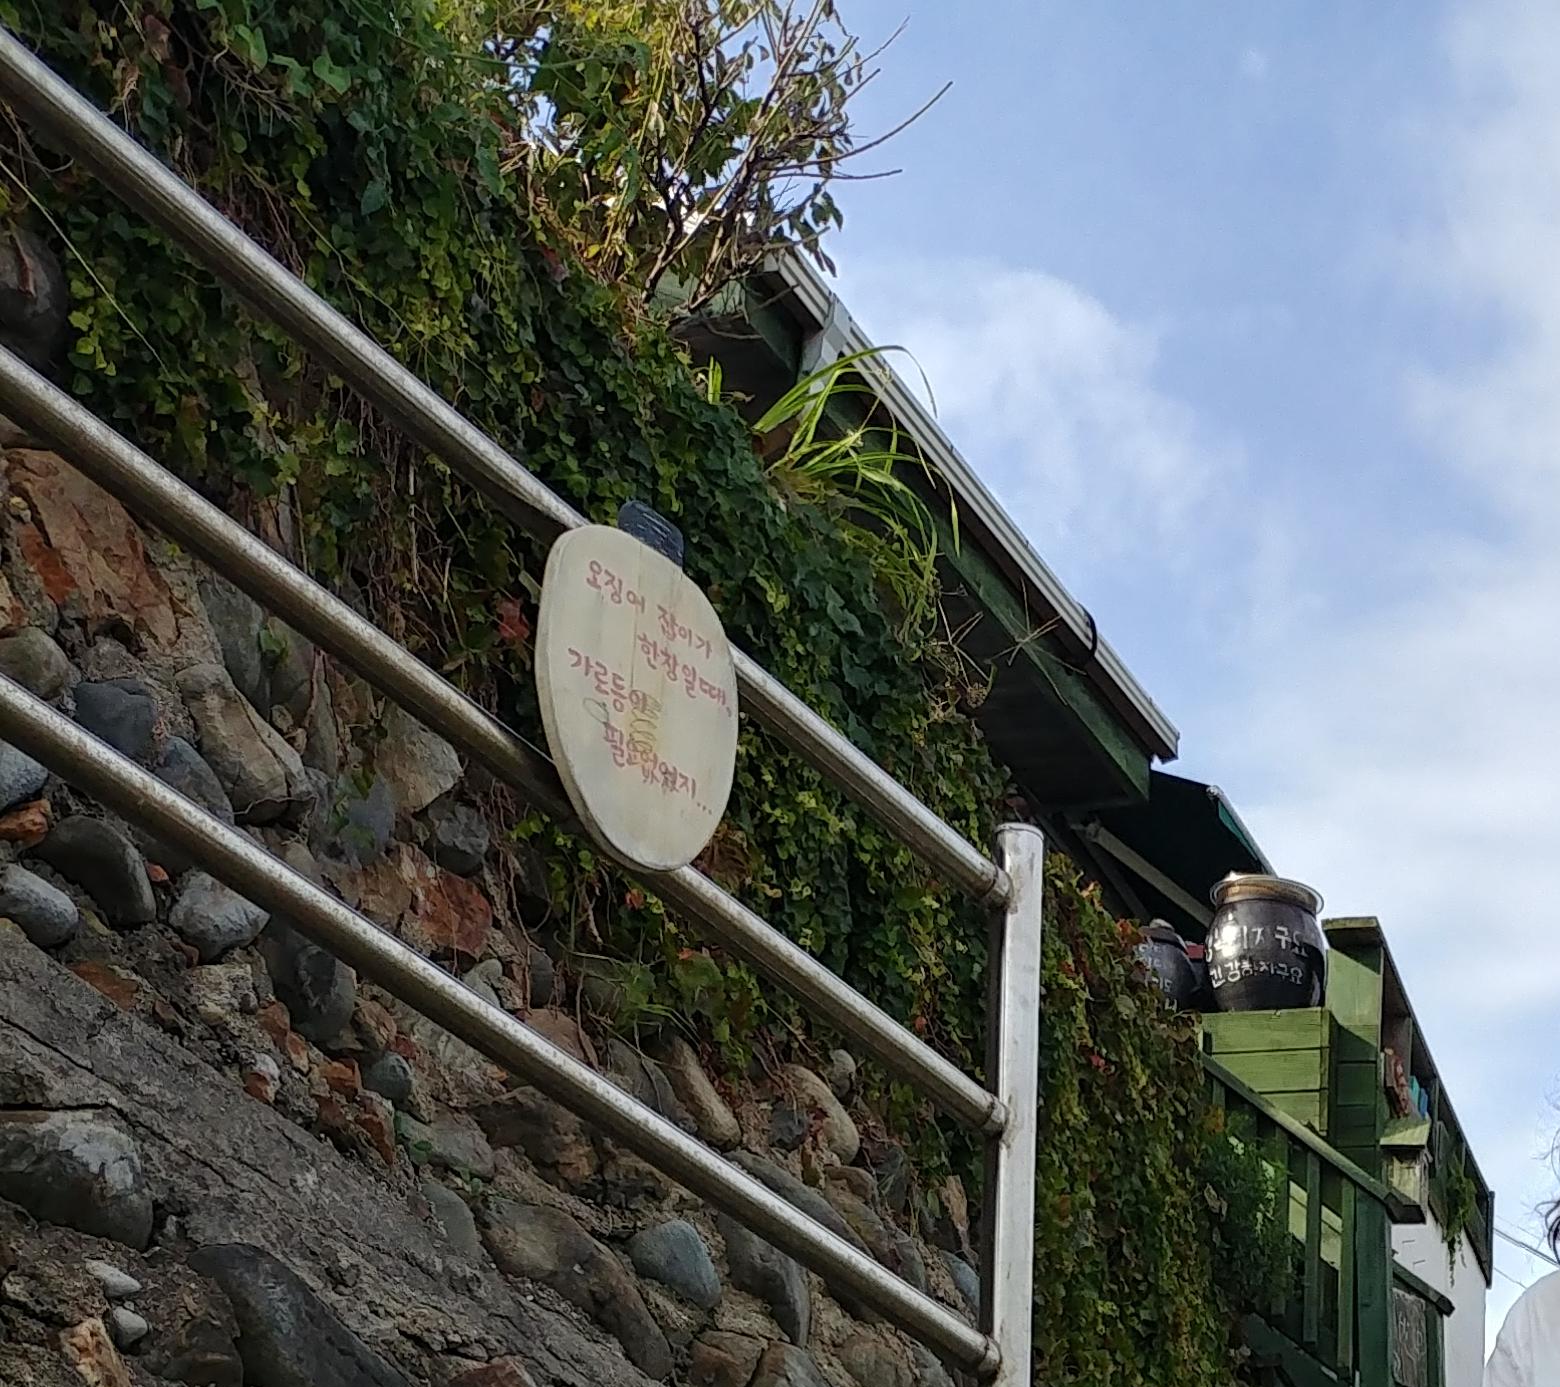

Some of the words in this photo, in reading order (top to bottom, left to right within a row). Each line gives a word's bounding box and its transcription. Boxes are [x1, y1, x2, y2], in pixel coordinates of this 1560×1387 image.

[587, 560, 645, 614] 오징어
[657, 604, 712, 660] 잡이가
[568, 647, 649, 713] 가로등이
